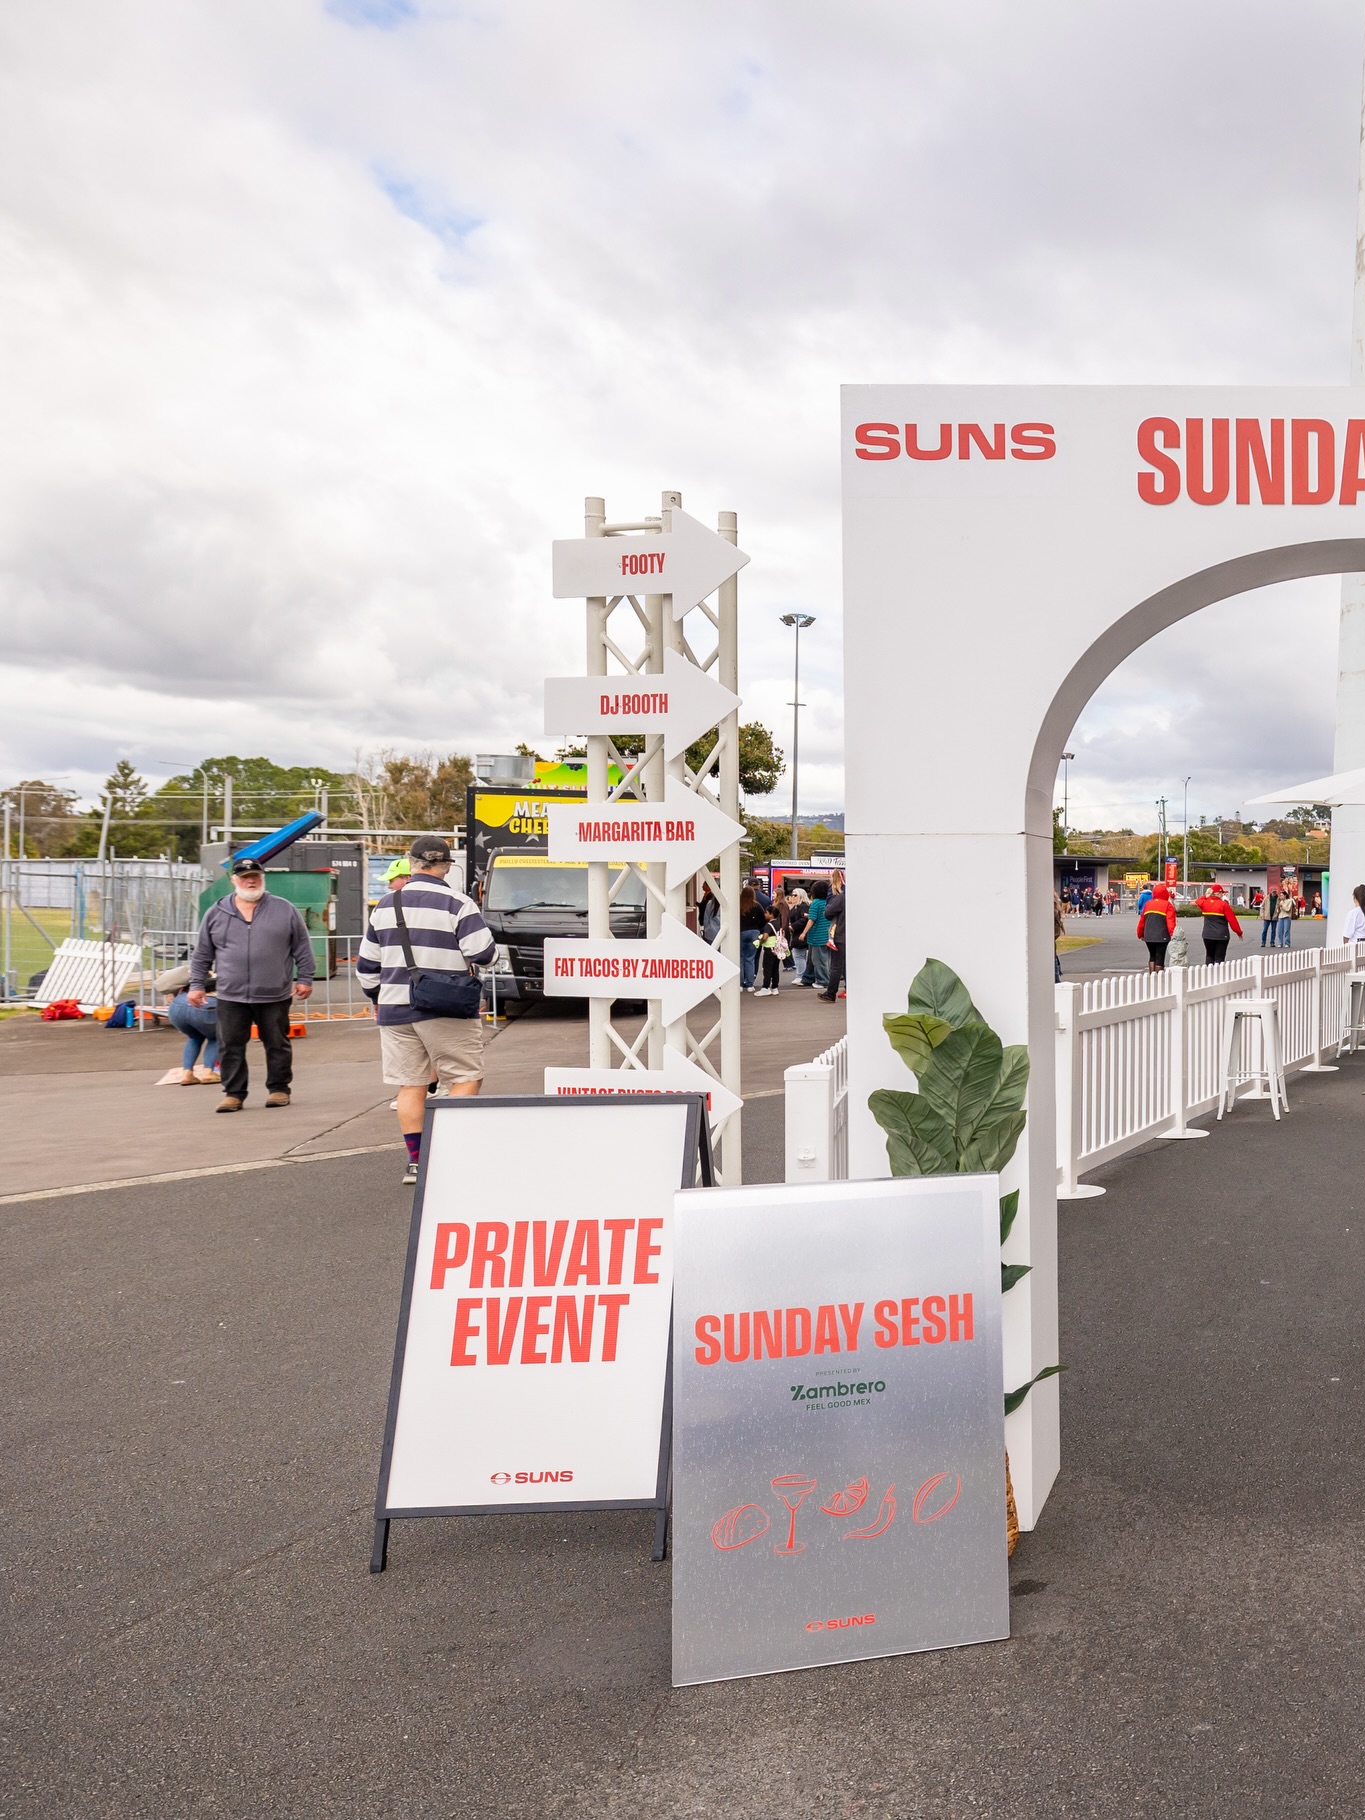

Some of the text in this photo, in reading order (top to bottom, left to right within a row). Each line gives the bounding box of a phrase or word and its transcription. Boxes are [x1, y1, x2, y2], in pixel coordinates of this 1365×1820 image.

[855, 422, 1056, 461] SUNS
[621, 553, 666, 575] FOOTY
[600, 693, 668, 715] DJ BOOTH
[578, 820, 695, 842] MARGARITA BAR
[555, 958, 714, 979] FAT TACOS BY ZAMBRERO
[429, 1217, 664, 1290] PRIVATE
[450, 1293, 630, 1367] EVENT
[694, 1293, 974, 1365] SUNDAY SESH
[815, 1368, 851, 1376] PRESENTED
[790, 1380, 886, 1401] Zambrero
[806, 1398, 871, 1411] FEEL GOOD MEX
[514, 1470, 574, 1484] SUNS
[826, 1613, 876, 1630] SUNS
